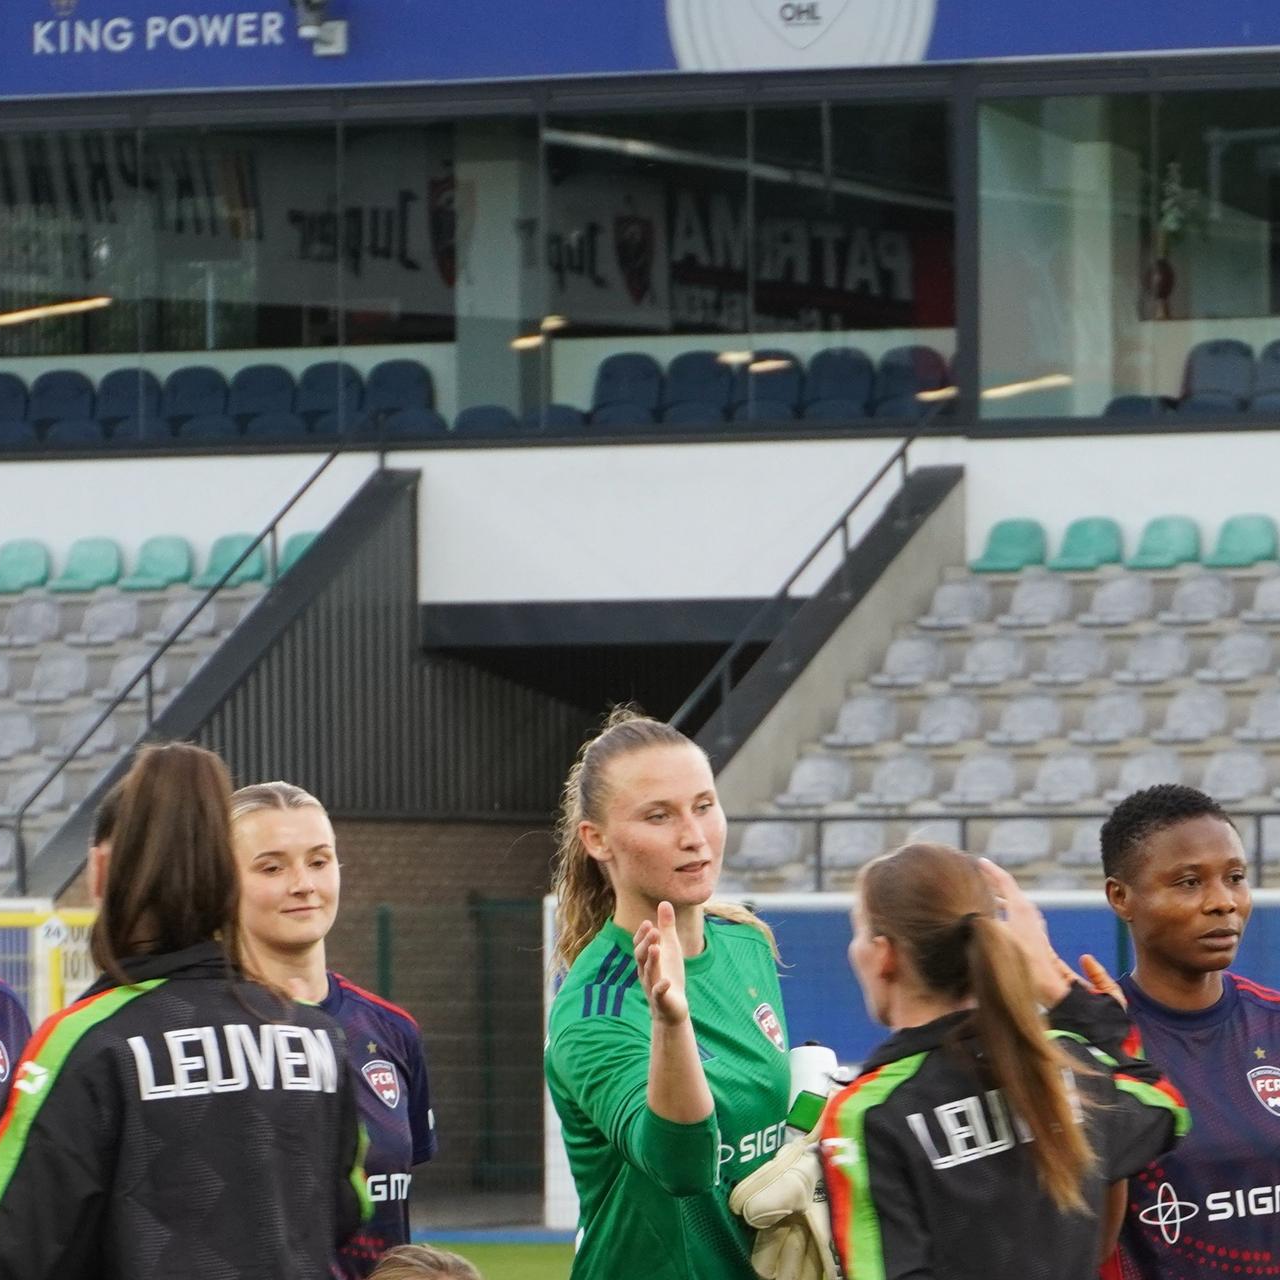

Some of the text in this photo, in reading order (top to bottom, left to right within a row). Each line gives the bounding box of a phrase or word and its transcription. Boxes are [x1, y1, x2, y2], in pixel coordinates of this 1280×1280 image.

[32, 11, 285, 54] KING POWER
[127, 1024, 338, 1101] LEUVEN
[370, 1072, 396, 1086] FCR
[739, 1119, 787, 1164] SIG
